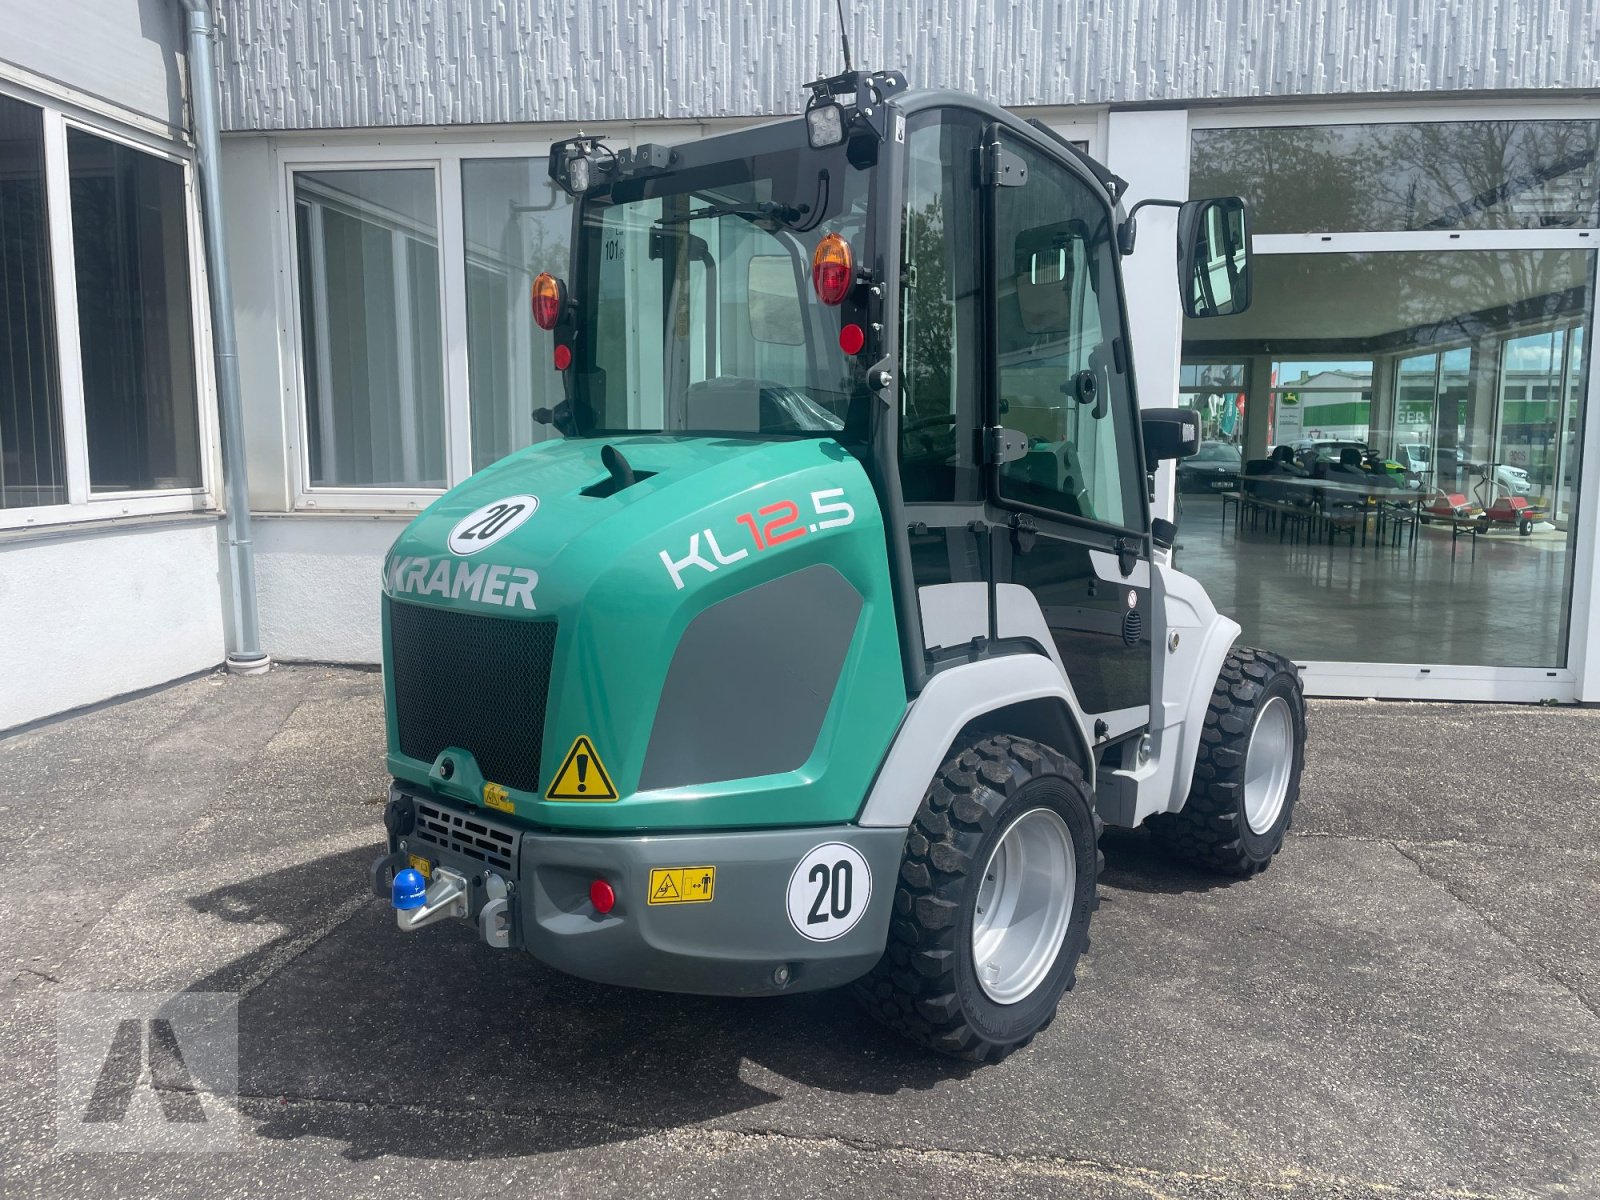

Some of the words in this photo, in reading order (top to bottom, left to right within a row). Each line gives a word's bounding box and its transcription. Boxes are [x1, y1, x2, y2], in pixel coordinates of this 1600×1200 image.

[458, 503, 525, 540] 20
[388, 556, 539, 611] KRAMER
[807, 859, 852, 925] 20
